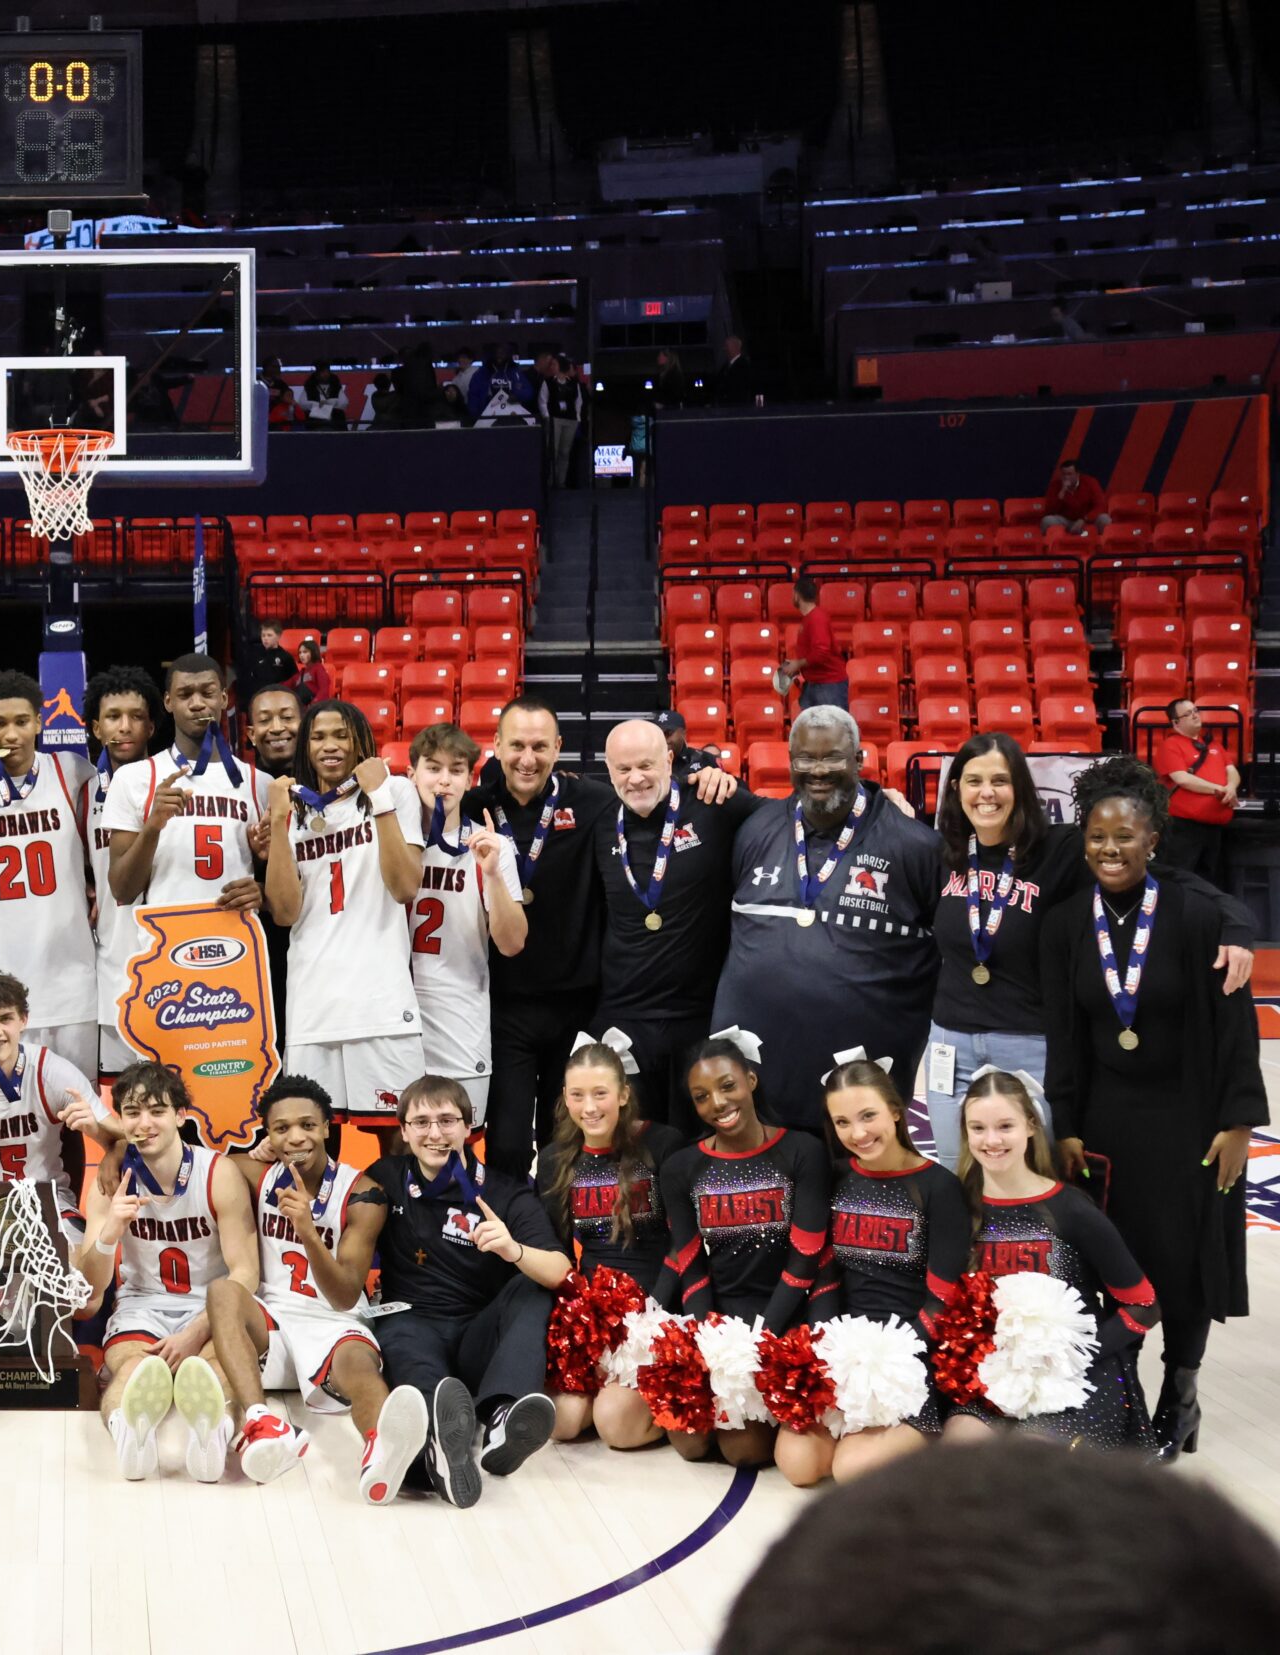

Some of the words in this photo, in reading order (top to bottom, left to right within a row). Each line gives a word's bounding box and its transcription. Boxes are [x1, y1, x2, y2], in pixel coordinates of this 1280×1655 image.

[43, 735, 61, 745] MARCH
[62, 735, 87, 745] MADNESS
[194, 824, 223, 880] 5
[295, 821, 373, 862] REDHAWKS
[856, 853, 891, 872] MARIST
[329, 859, 345, 915] 1
[838, 895, 889, 914] BASKETBALL
[188, 943, 228, 961] IHSA
[146, 982, 180, 1008] 2026
[186, 986, 236, 1009] State
[160, 1004, 250, 1027] Champion
[183, 1042, 210, 1051] PROUD
[211, 1039, 248, 1049] PARTNER
[200, 1061, 247, 1073] COUNTRY
[701, 1190, 784, 1227] MARIST
[130, 1216, 211, 1242] REDHAWKS
[441, 1234, 475, 1247] BASKETBALL
[159, 1247, 192, 1294] 0
[281, 1251, 317, 1298] 2
